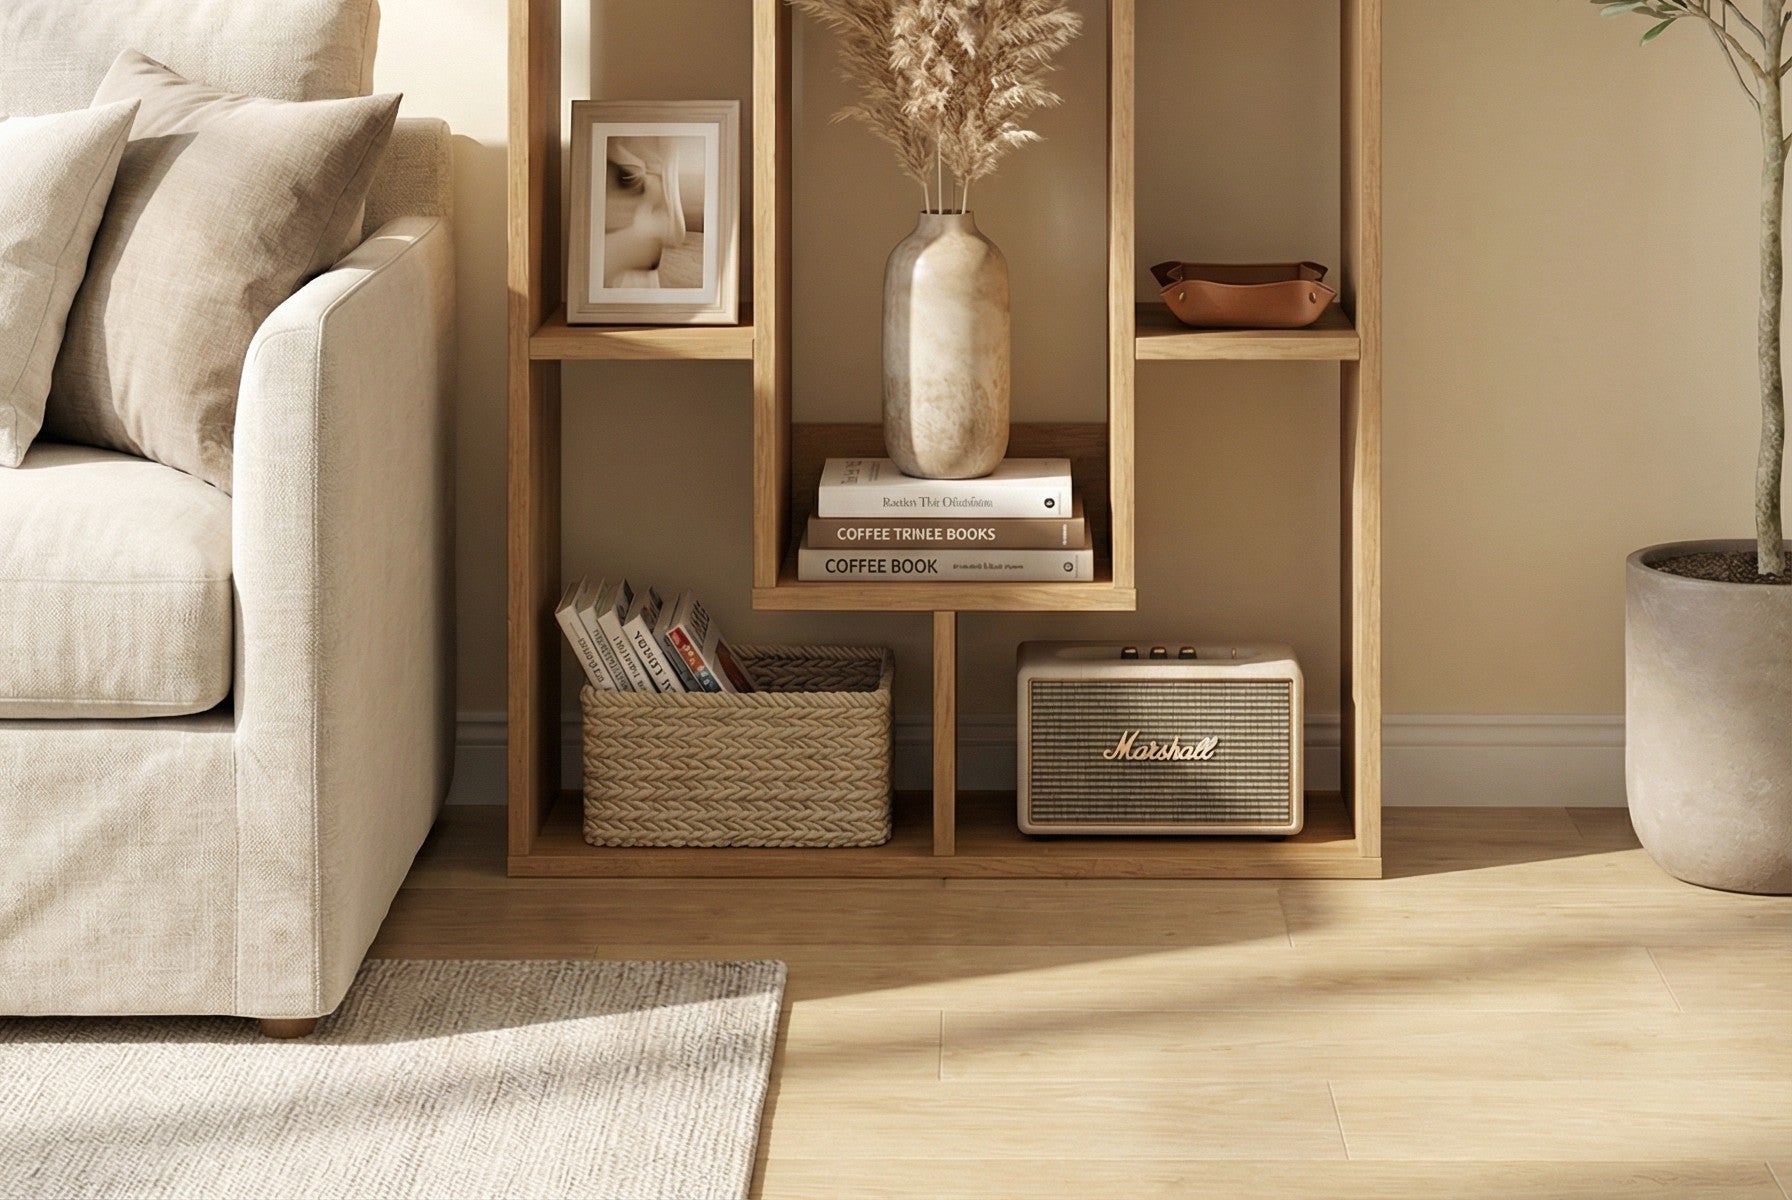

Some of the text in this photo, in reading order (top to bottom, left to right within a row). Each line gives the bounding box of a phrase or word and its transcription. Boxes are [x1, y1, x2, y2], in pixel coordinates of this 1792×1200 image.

[837, 527, 996, 541] COFFEE TRINEE BOOKS
[825, 558, 887, 574] COFFEE
[891, 558, 938, 574] BOOK
[1103, 728, 1220, 761] Marshall
